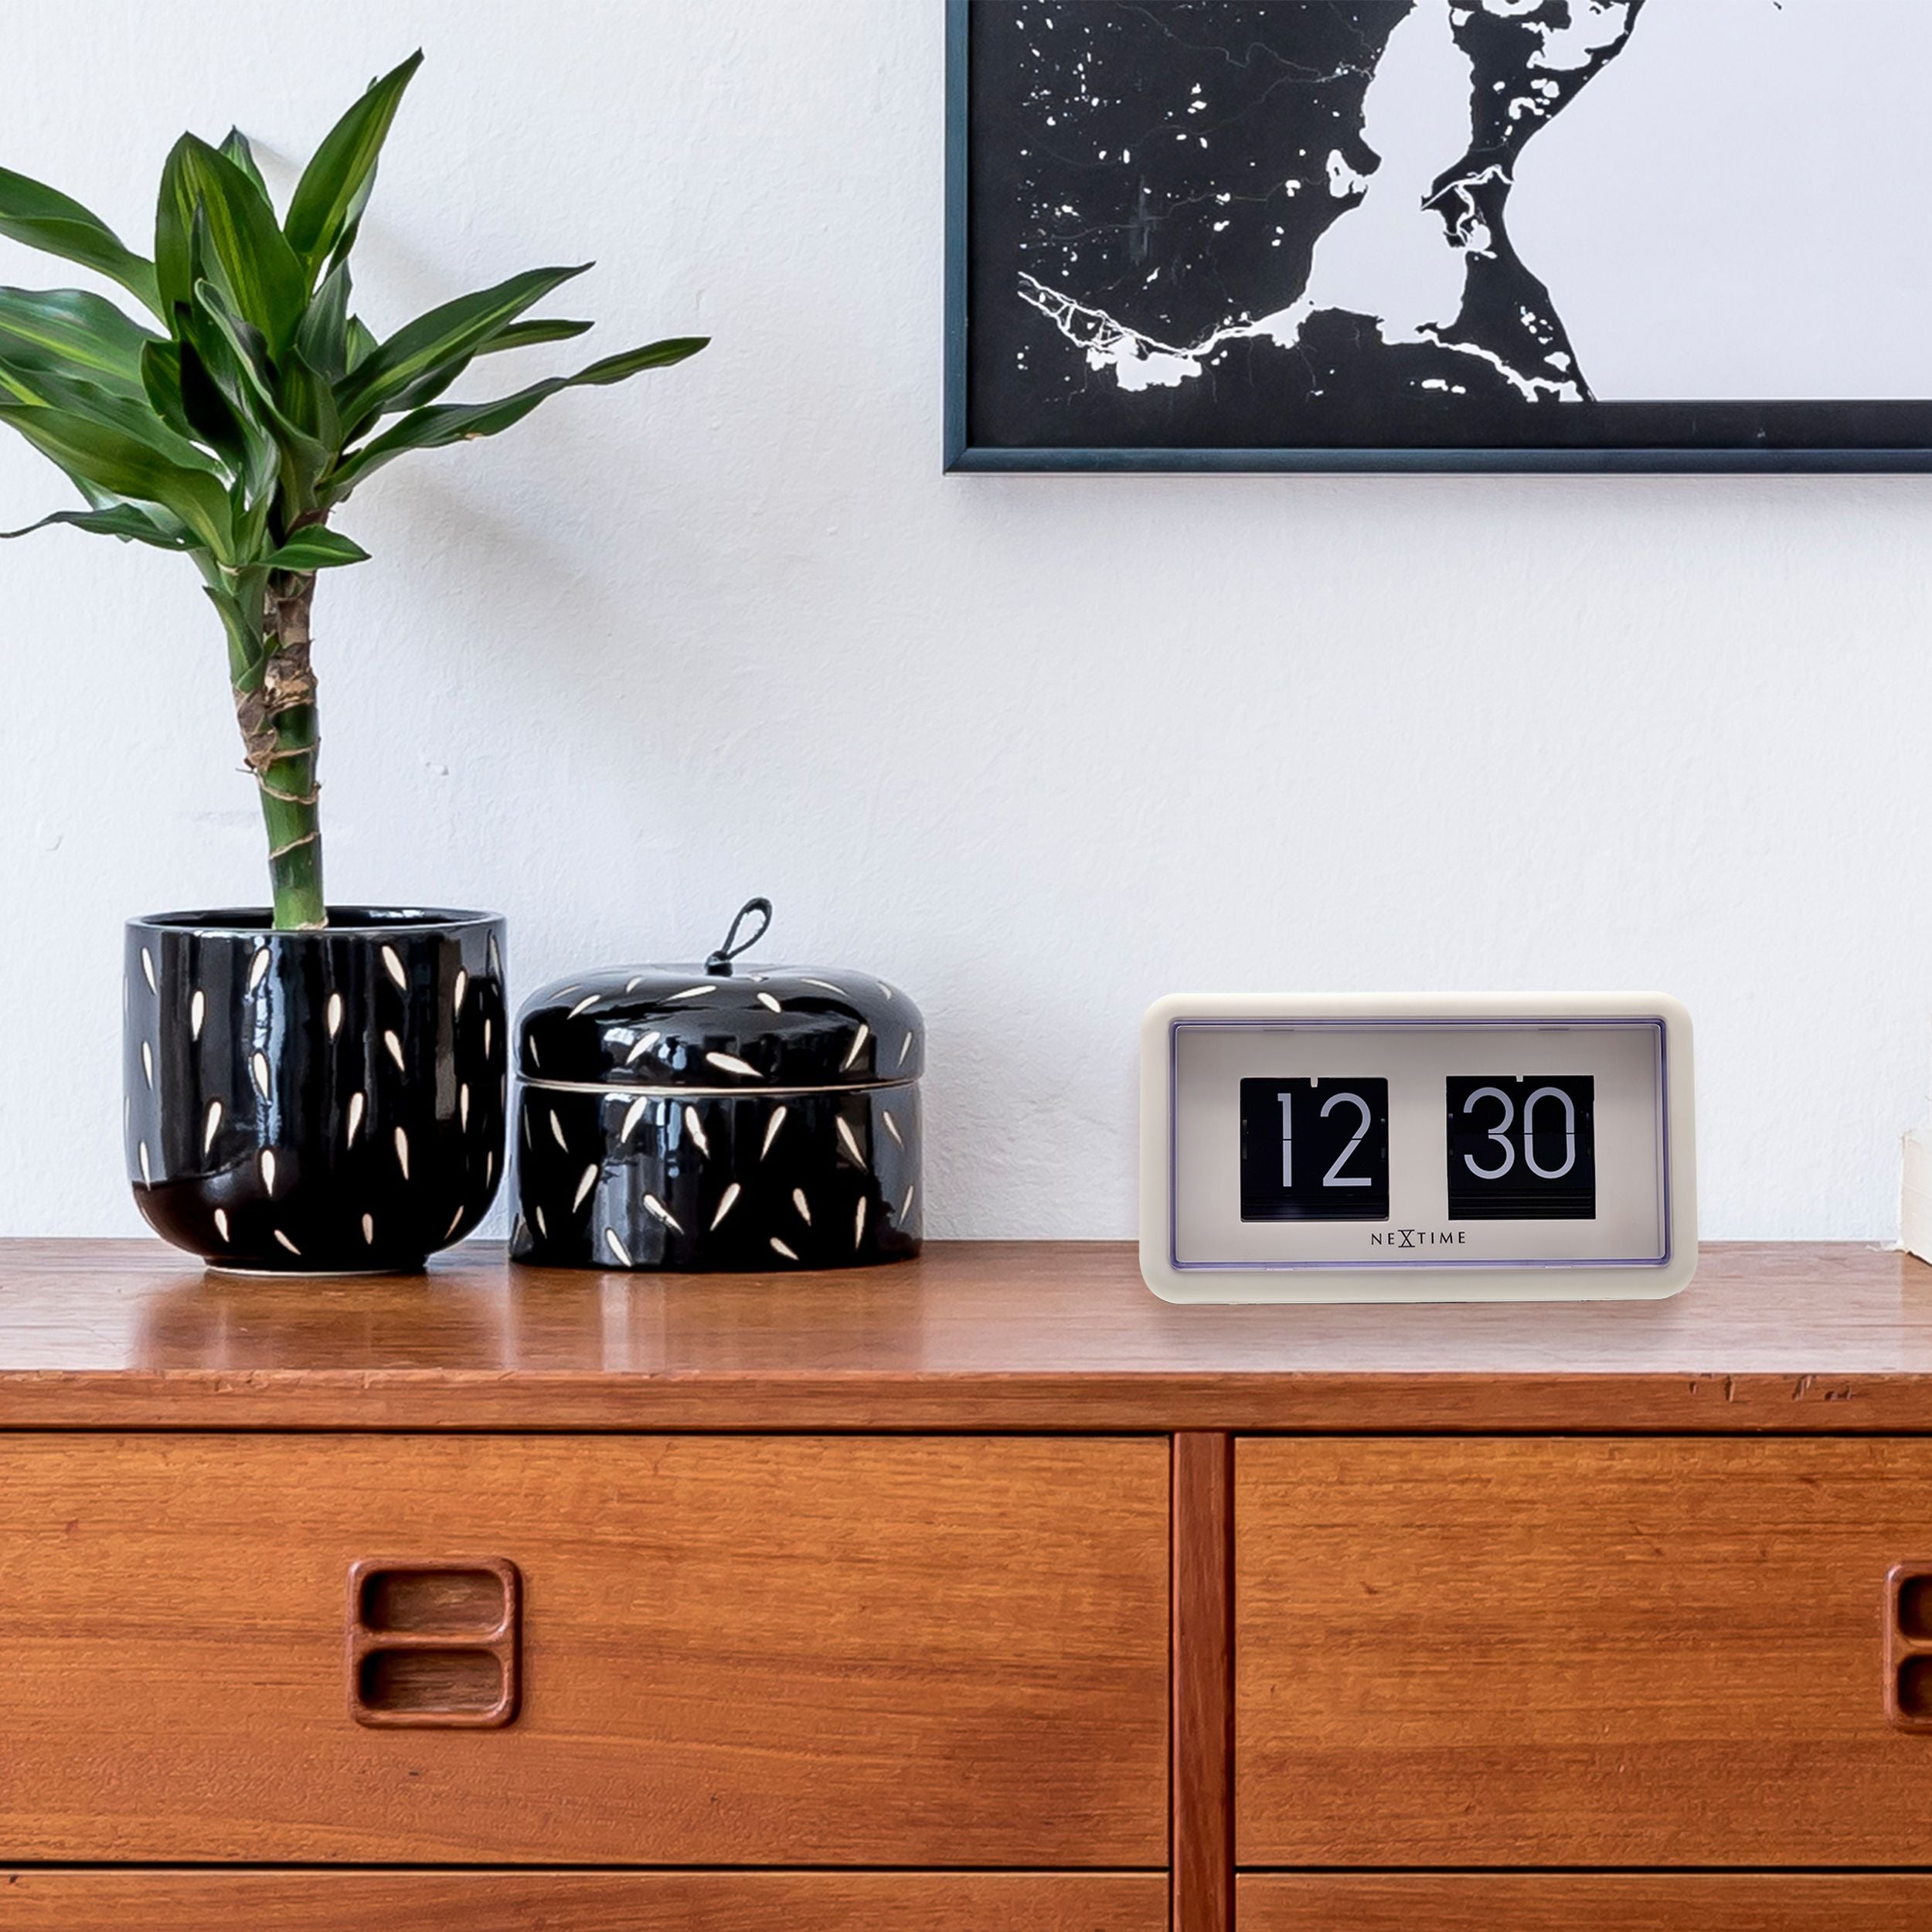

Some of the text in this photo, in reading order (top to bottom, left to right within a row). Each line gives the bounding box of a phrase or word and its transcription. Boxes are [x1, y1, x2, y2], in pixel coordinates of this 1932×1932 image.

[1277, 1087, 1576, 1187] 12 30
[1370, 1229, 1467, 1248] NEXTIME
